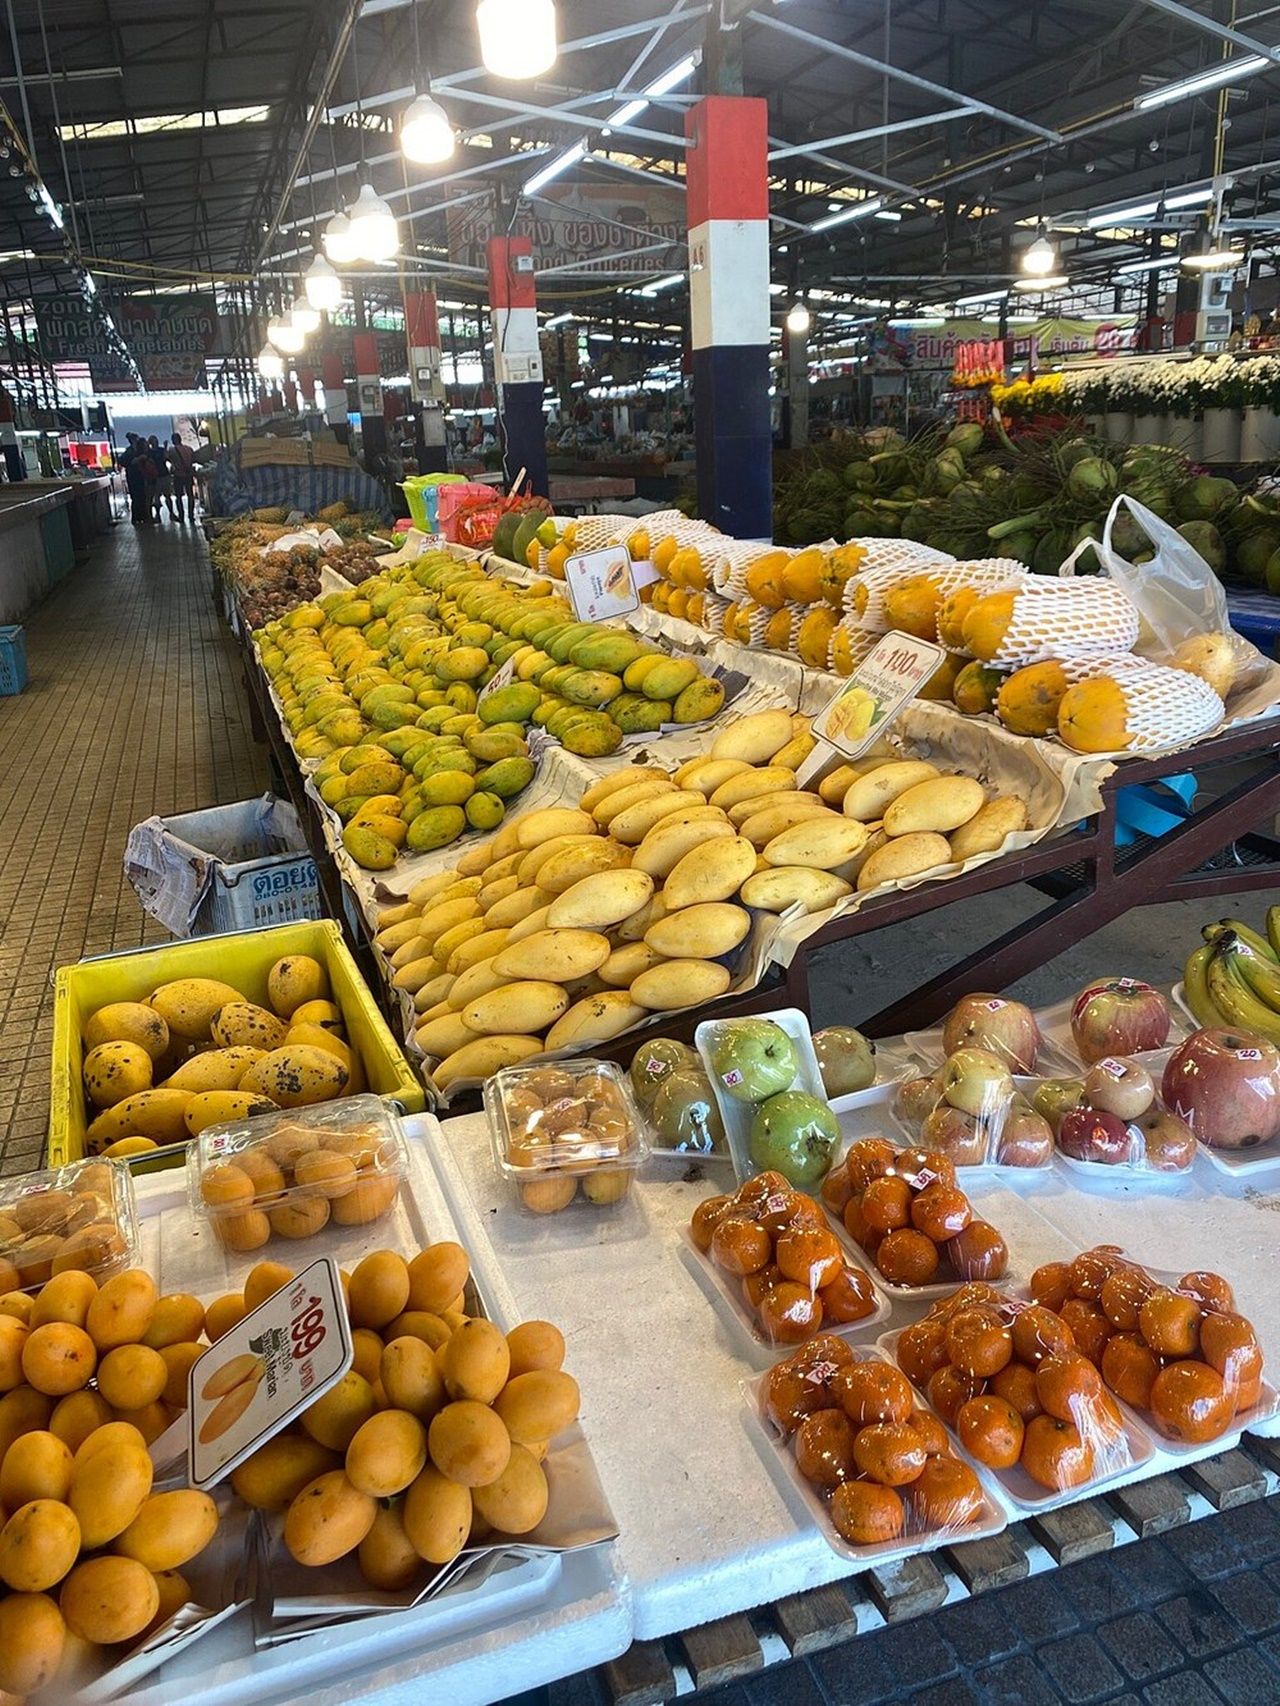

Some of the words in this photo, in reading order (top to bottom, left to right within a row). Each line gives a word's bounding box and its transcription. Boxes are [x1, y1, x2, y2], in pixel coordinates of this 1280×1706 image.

[126, 338, 206, 355] egetables
[290, 1296, 327, 1360] 199
[265, 1358, 278, 1399] Marian
[298, 1358, 316, 1392] บาท
